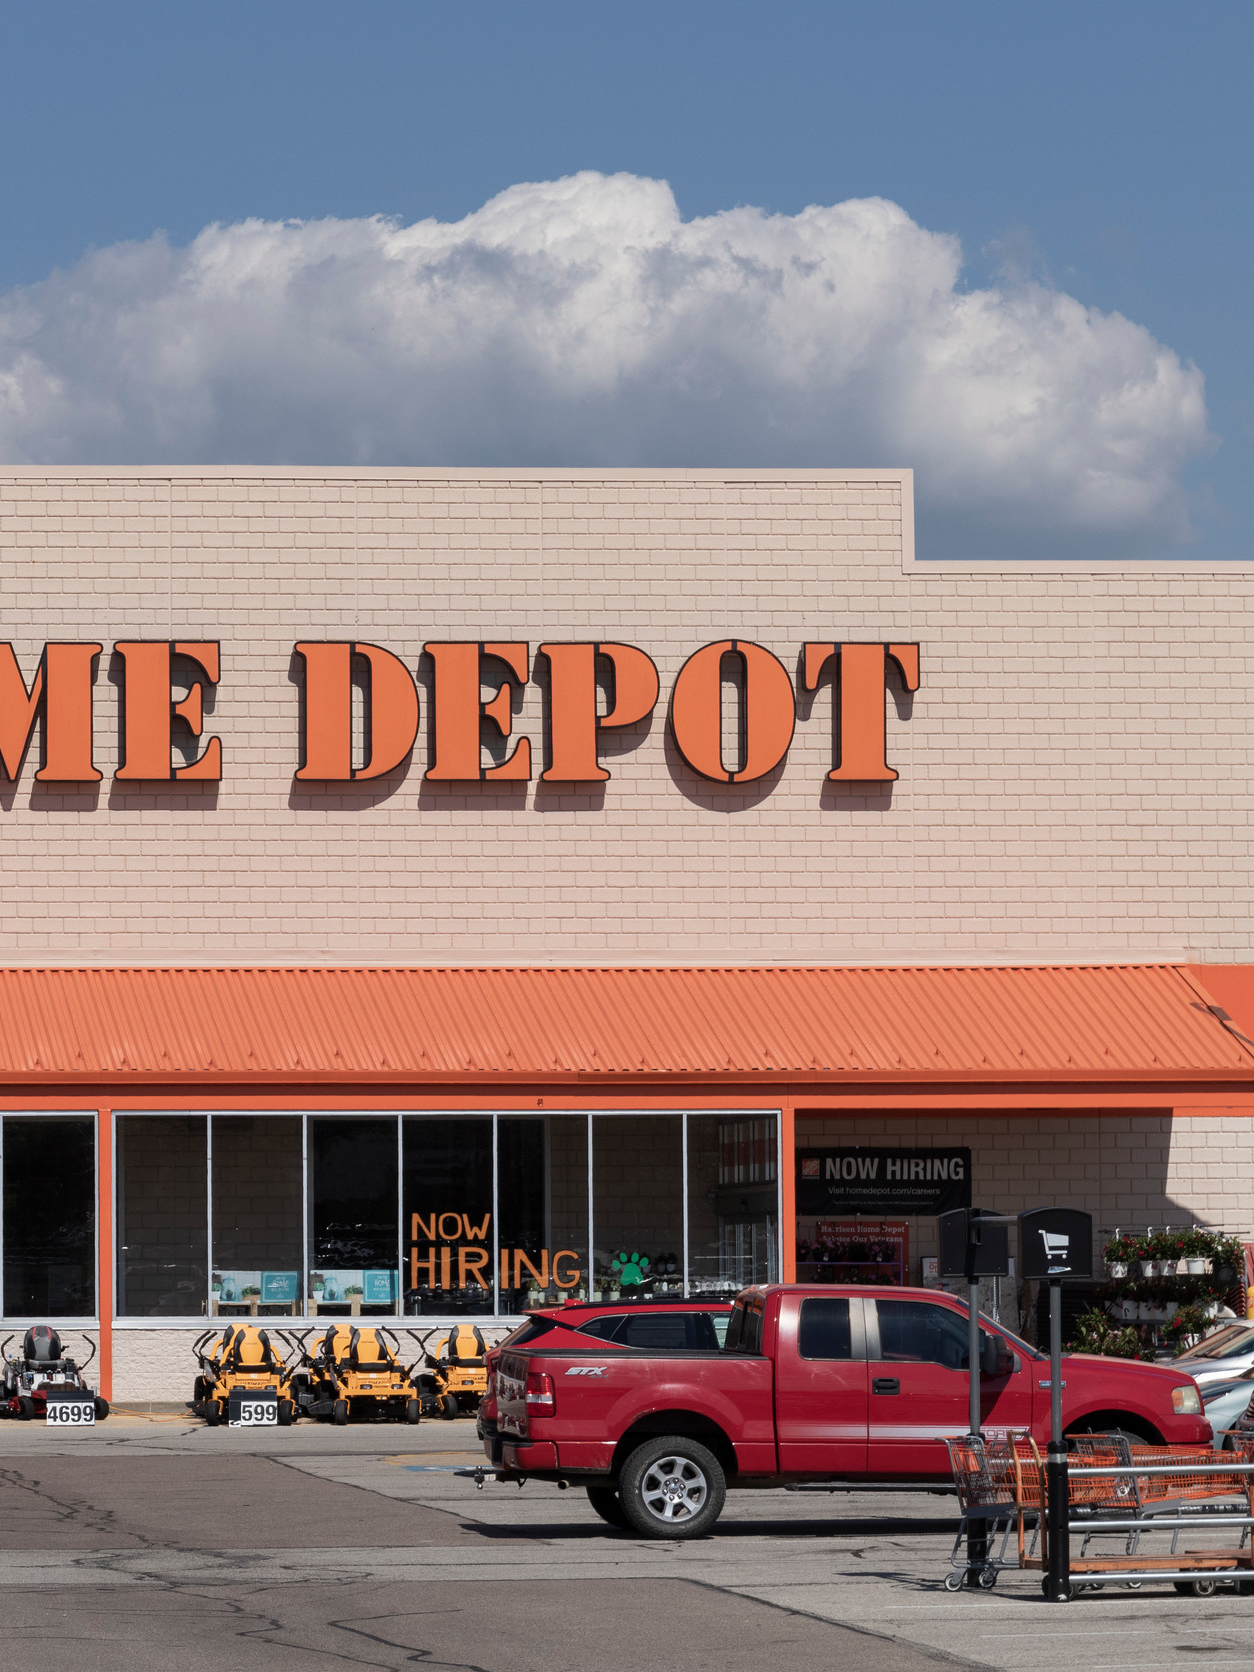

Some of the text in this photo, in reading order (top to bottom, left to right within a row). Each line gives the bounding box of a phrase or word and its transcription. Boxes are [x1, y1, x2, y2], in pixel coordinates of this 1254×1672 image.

[293, 638, 921, 786] DEPOT
[825, 1157, 879, 1180] NOW
[886, 1157, 965, 1181] HIRING
[828, 1186, 941, 1196] Visit homedepot.com/careers
[411, 1212, 491, 1241] NOW
[858, 1225, 880, 1233] Home
[411, 1246, 582, 1290] HIRING
[565, 1366, 608, 1376] STX
[47, 1405, 94, 1423] 4699
[241, 1403, 277, 1422] 599
